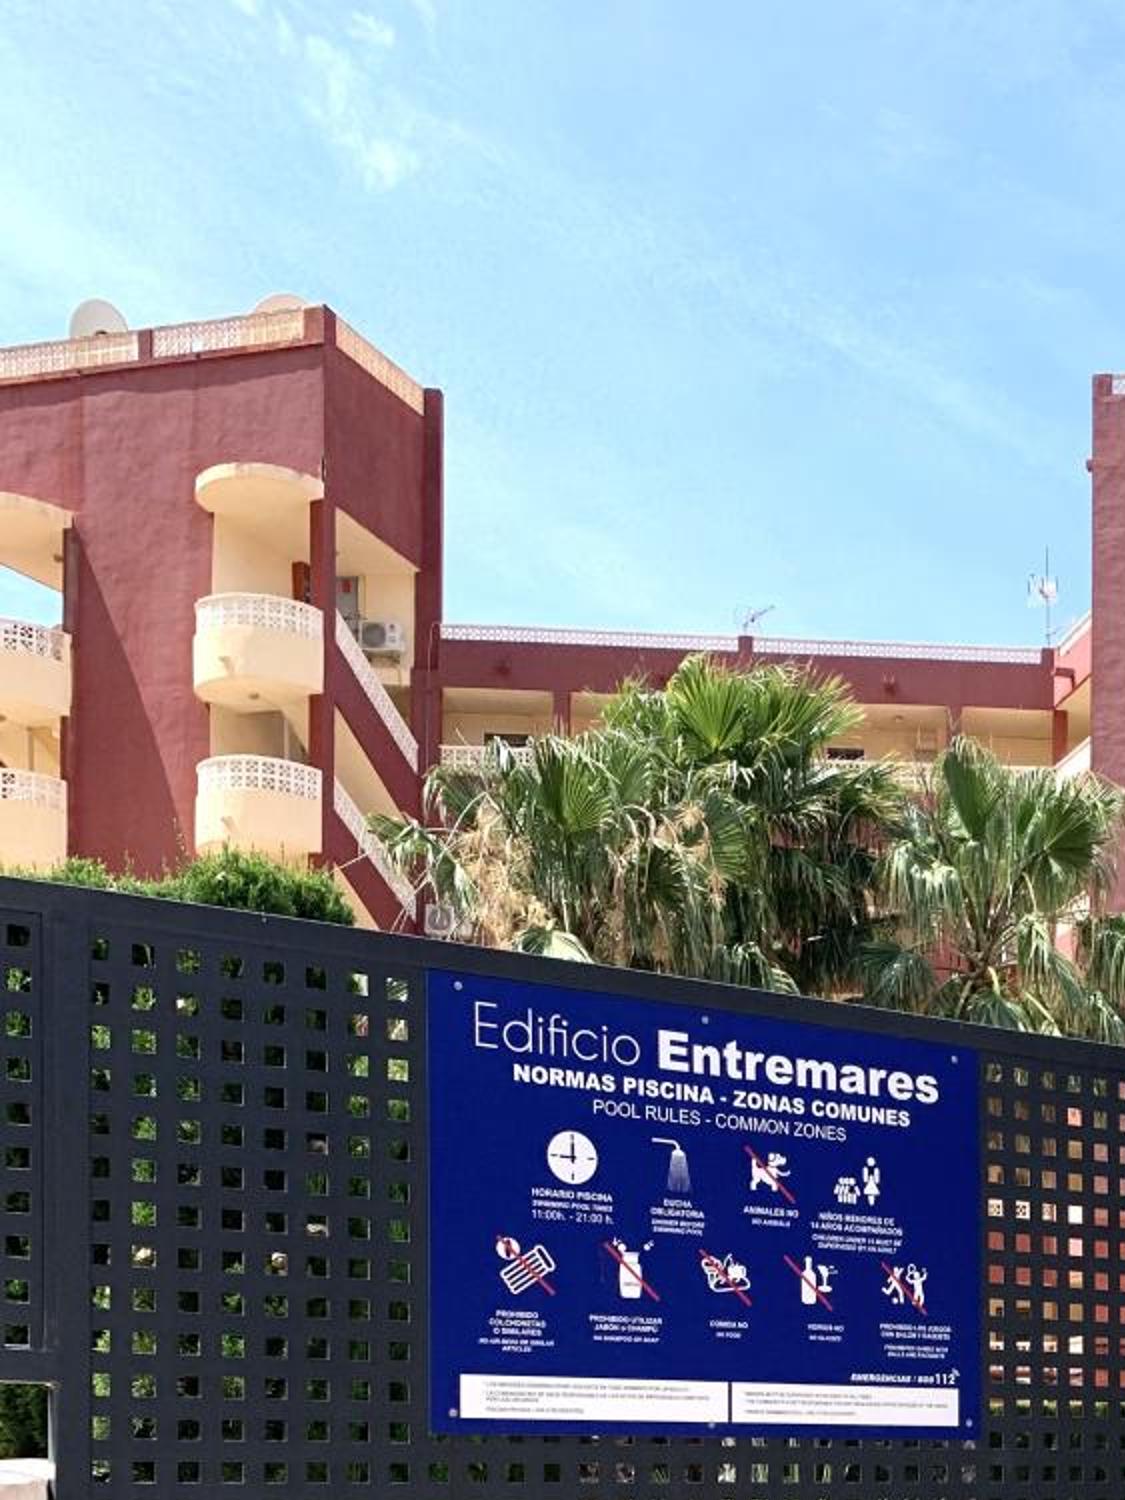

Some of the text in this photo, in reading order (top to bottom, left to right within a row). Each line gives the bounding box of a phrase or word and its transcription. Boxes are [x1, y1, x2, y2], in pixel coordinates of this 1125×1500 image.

[474, 1001, 939, 1104] Edificio Entremares
[512, 1063, 616, 1093] NORMAS
[623, 1076, 715, 1105] PISCINA
[732, 1089, 805, 1115] ZONAS
[811, 1099, 911, 1128] COMUNES
[592, 1099, 641, 1120] POOL
[645, 1105, 701, 1126] RULES
[715, 1112, 790, 1135] COMMON
[793, 1121, 847, 1143] ZONES
[531, 1187, 613, 1203] HORARIO PISCINA
[743, 1205, 785, 1217] ANIMALES
[936, 1373, 956, 1385] 112
